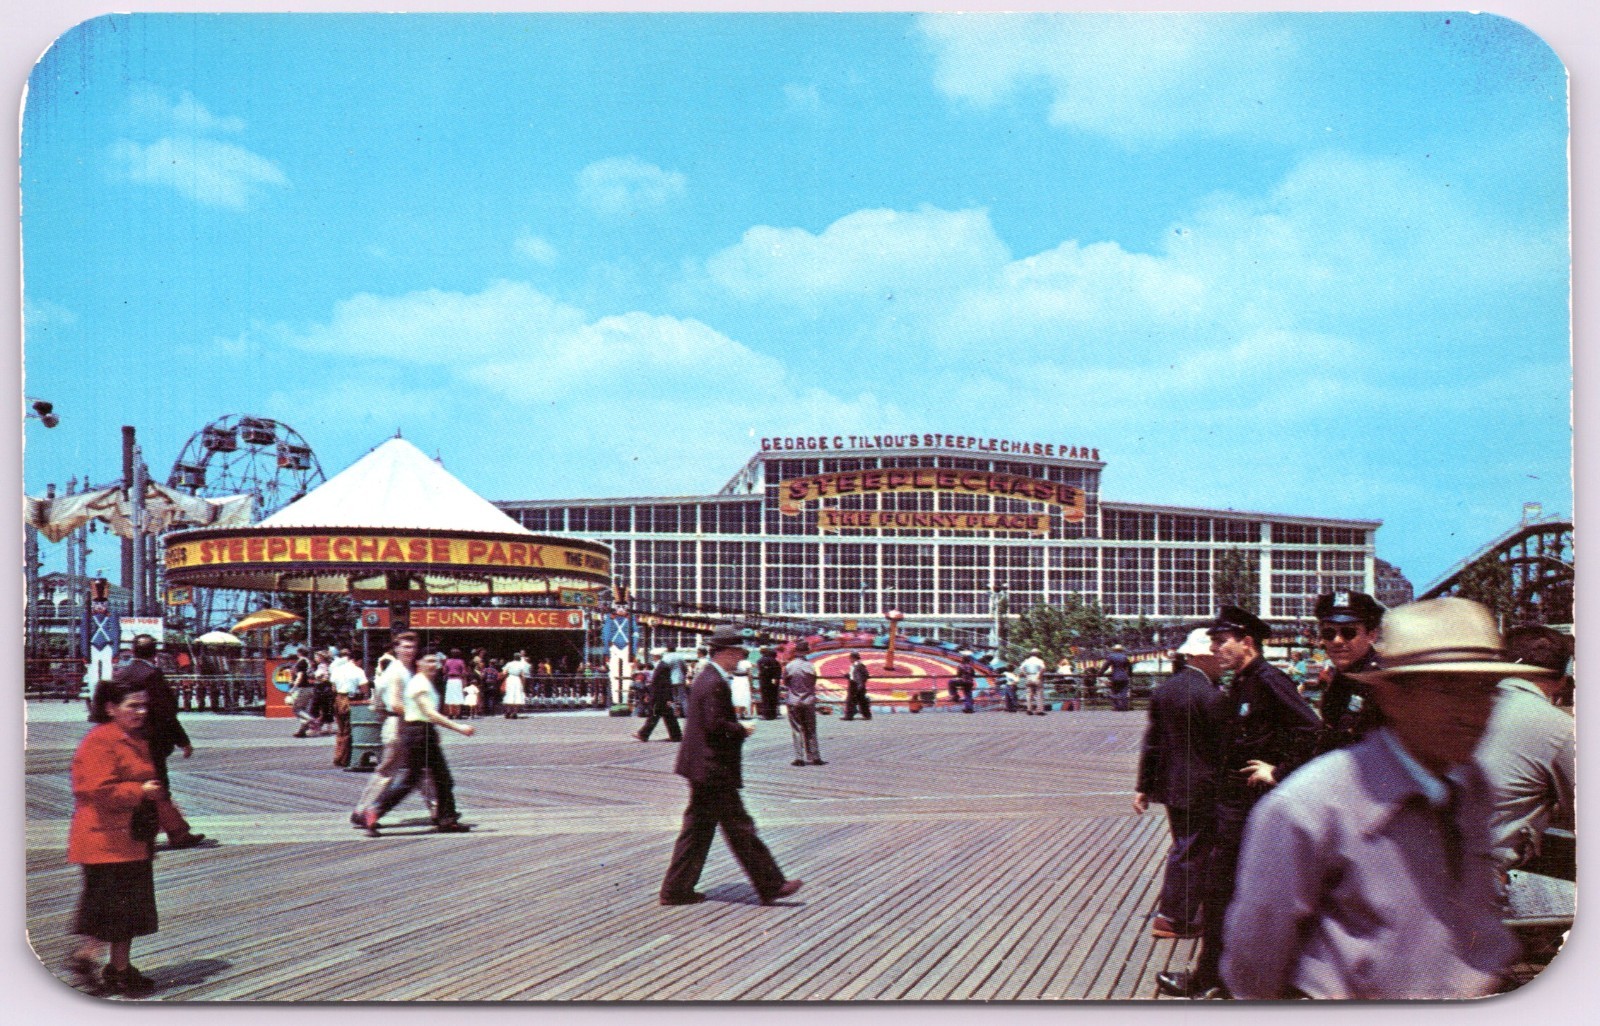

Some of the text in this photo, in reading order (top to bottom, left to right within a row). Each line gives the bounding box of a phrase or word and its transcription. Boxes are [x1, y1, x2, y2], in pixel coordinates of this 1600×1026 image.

[761, 433, 1099, 460] GEORGE C TILYOU'S STEEPLECHASE PARK
[789, 470, 1077, 506] STEEPLECHASE
[827, 512, 1039, 530] THE FUNNY PLACE
[200, 537, 451, 563] STEEPLECHASE
[467, 540, 544, 567] PARK
[564, 551, 583, 567] THE
[427, 611, 492, 626] FUNNY
[499, 612, 559, 626] PLACE
